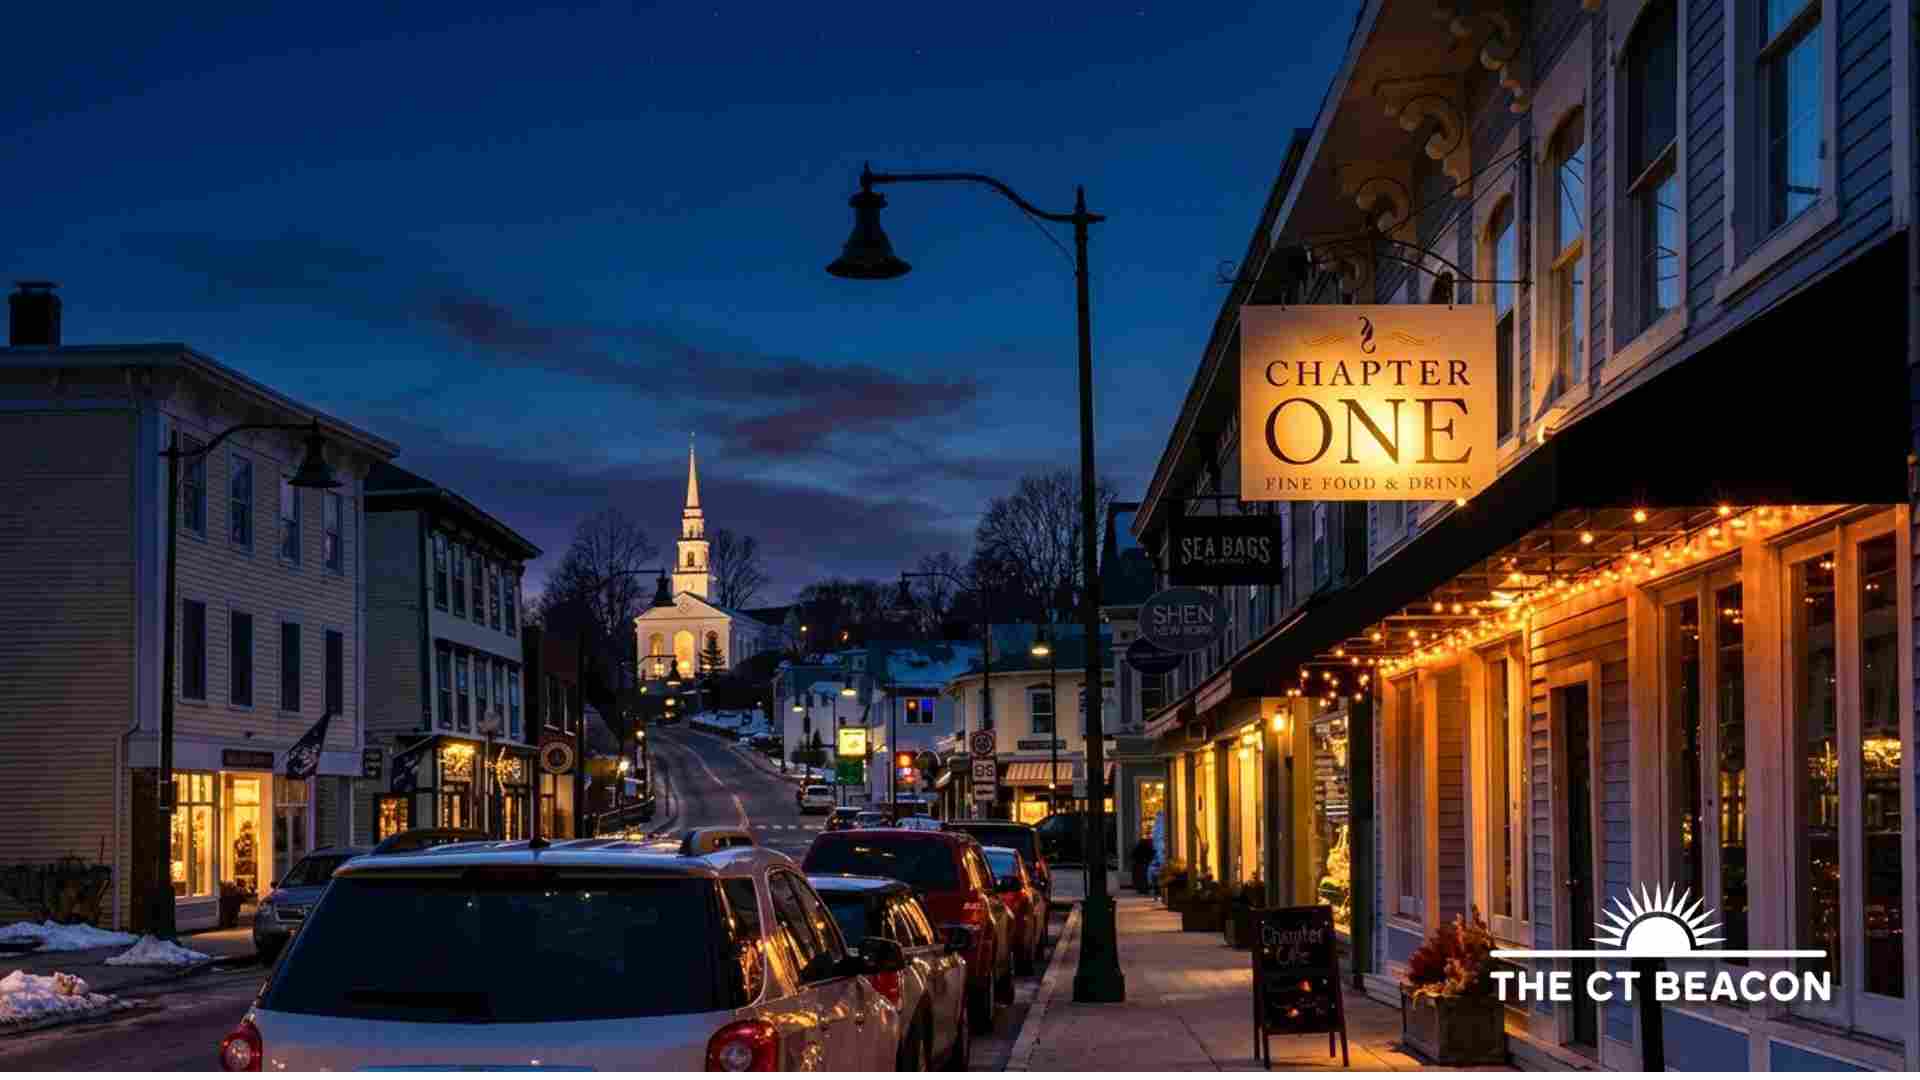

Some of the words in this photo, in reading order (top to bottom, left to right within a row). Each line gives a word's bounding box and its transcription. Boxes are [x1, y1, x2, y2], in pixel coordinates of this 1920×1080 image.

[1264, 359, 1473, 387] CHAPTER
[1264, 397, 1473, 466] ONE
[1265, 476, 1313, 491] FINE
[1321, 476, 1377, 491] FOOD
[1384, 477, 1400, 491] &
[1408, 476, 1473, 491] DRINK
[1180, 536, 1215, 566] SEA
[1221, 535, 1272, 566] BAGS
[1152, 605, 1216, 625] SHEN
